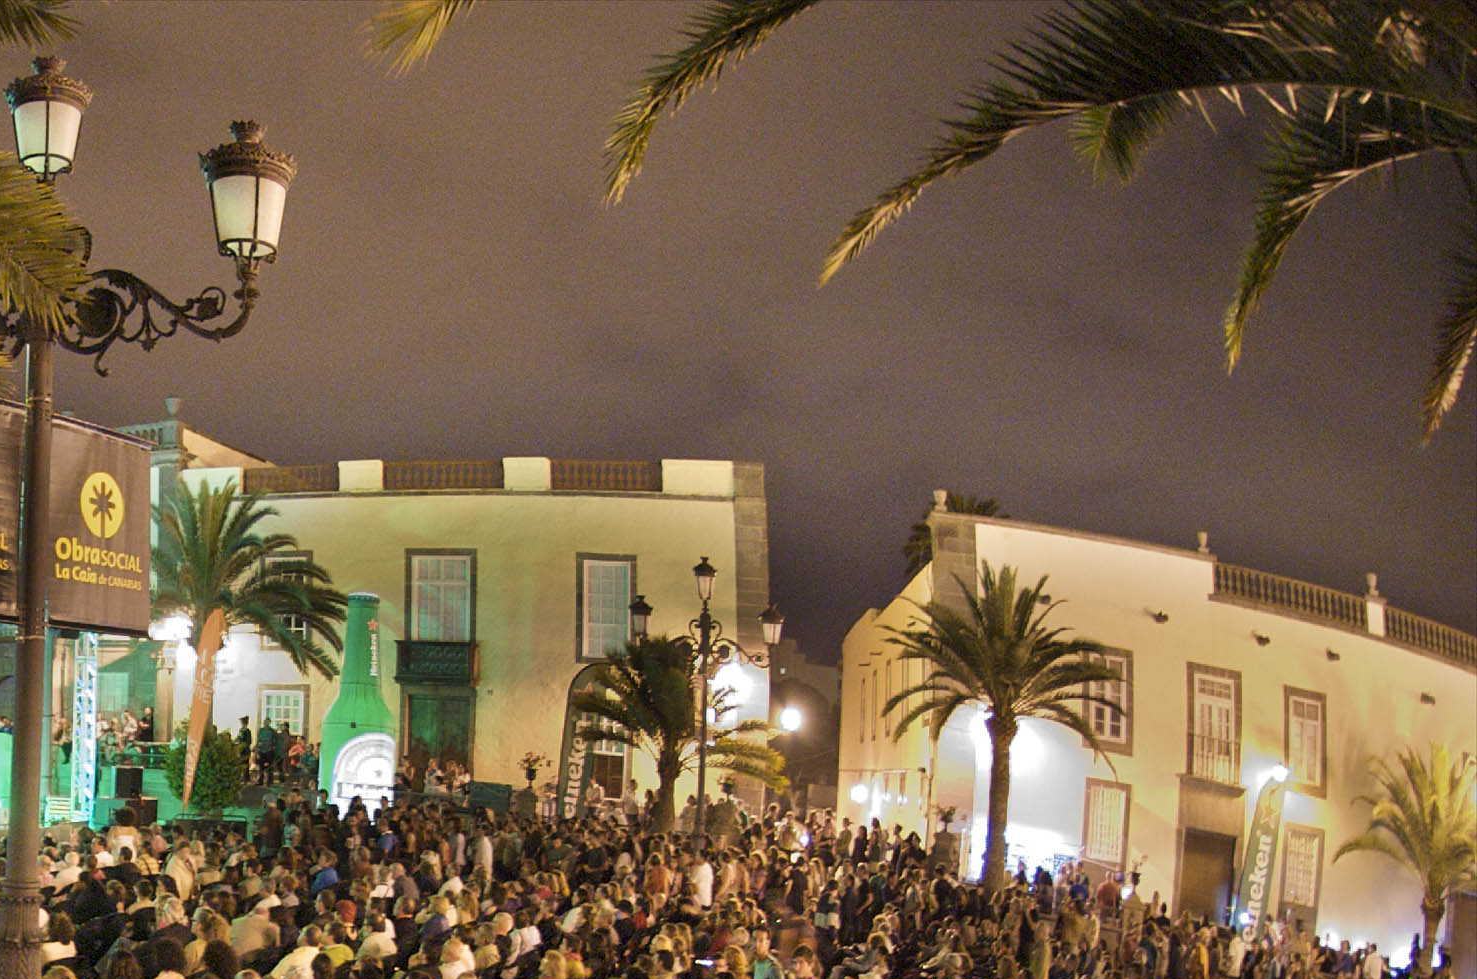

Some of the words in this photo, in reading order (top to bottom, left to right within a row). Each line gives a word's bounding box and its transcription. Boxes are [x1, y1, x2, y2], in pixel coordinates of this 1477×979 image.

[55, 563, 70, 579] La
[72, 565, 97, 584] Caja
[99, 573, 107, 585] de
[108, 575, 143, 591] CANARIAS
[563, 718, 593, 819] eineken
[1243, 834, 1273, 942] eineken
